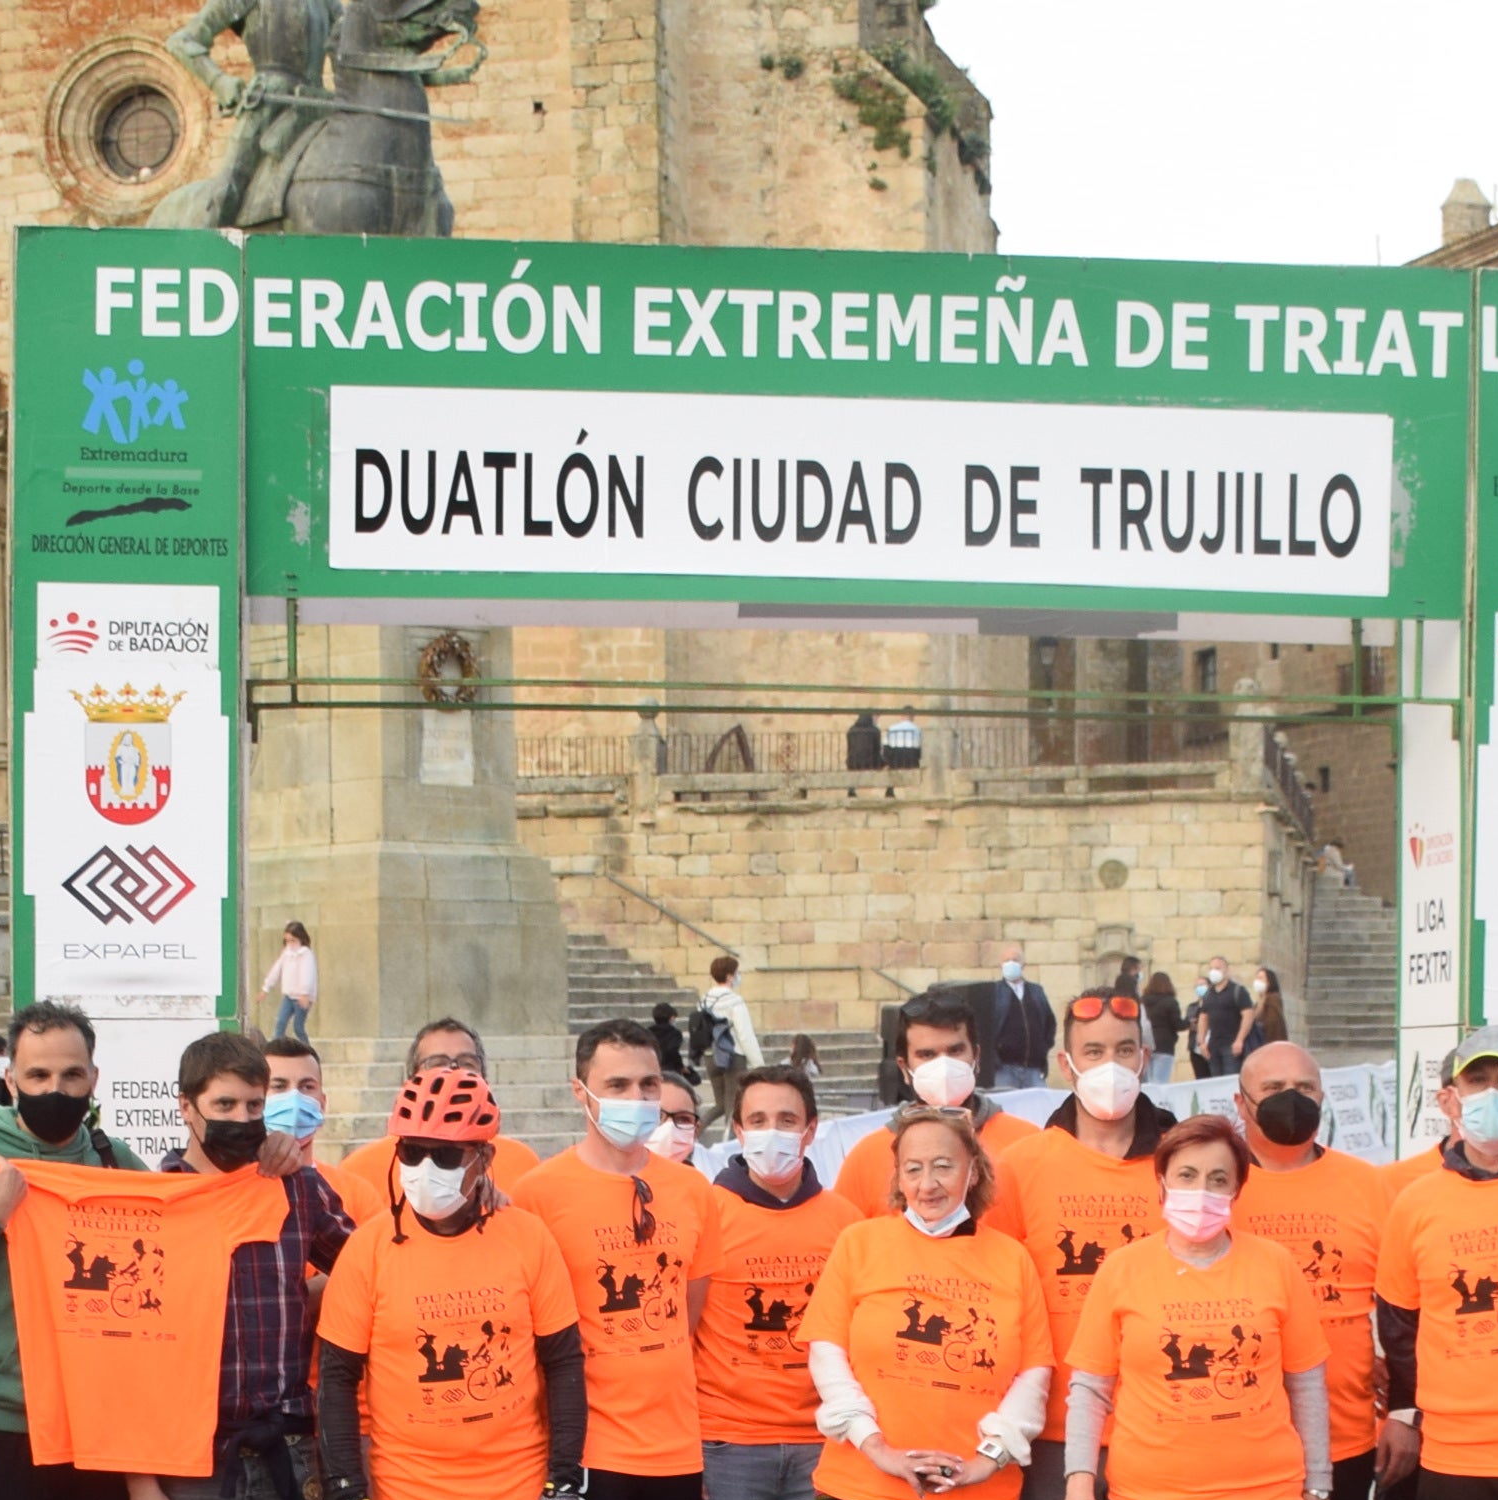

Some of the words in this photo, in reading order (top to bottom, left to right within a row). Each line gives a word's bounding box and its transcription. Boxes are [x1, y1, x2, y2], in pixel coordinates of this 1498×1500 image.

[95, 259, 601, 354] FEDERACIÓN
[634, 276, 1088, 366] EXTREMEÑA
[1116, 301, 1210, 370] DE
[80, 447, 188, 463] Extremadura
[62, 482, 111, 496] Deporte
[116, 483, 151, 495] desde
[156, 484, 167, 495] la
[172, 484, 199, 496] Base
[355, 428, 644, 538] DUATLÓN
[687, 456, 921, 544] CIUDAD
[965, 465, 1039, 547] DE
[1081, 467, 1361, 558] TRUJILLO
[32, 533, 94, 553] DIRECCIÓN
[98, 535, 151, 555] GENERAL
[154, 537, 168, 555] DE
[173, 538, 228, 556] DEPORTES
[108, 618, 209, 637] DIPUTACIÓN
[108, 640, 124, 651] DE
[129, 637, 209, 653] BADAJOZ
[1416, 898, 1445, 933] LIGA
[63, 943, 197, 960] EXPAPEL
[1408, 950, 1452, 986] FEXTRI
[111, 1081, 180, 1099] FEDERAC
[115, 1109, 185, 1127] EXTREME
[1061, 1209, 1149, 1219] TRUJILLO
[71, 1219, 161, 1234] TRUJILLO
[1253, 1226, 1338, 1236] TRUJILLO
[417, 1302, 506, 1321] TRUJILLO
[1165, 1310, 1256, 1322] TRUJILLO
